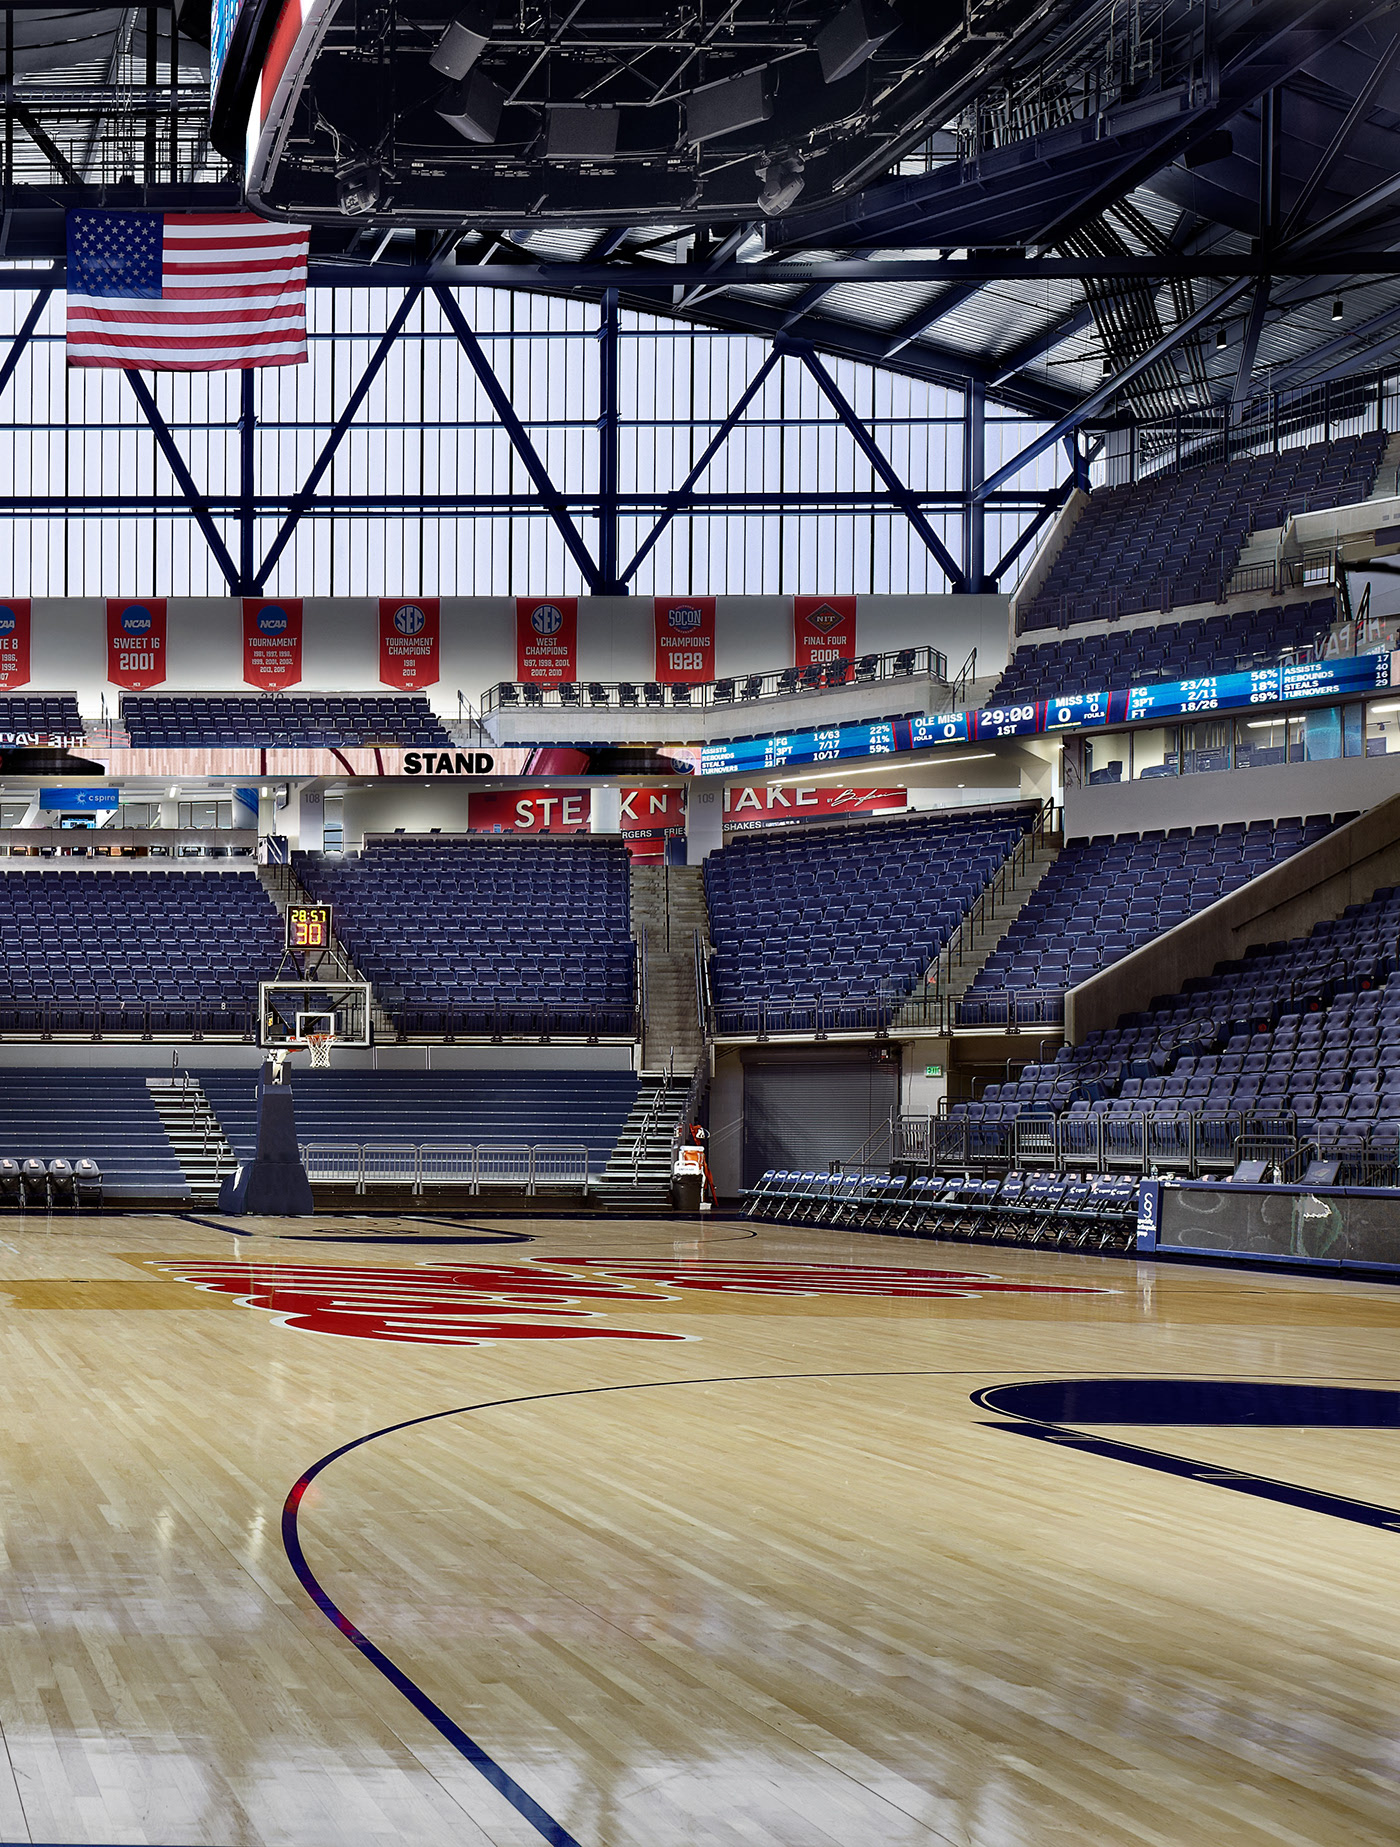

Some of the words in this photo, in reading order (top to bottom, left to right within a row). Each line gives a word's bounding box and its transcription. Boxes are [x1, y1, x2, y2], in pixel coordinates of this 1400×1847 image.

[124, 620, 150, 628] NCAA
[260, 620, 286, 628] NCAA
[397, 608, 422, 632] SEC
[534, 608, 560, 632] SEC
[12, 639, 18, 649] 8
[114, 638, 148, 648] SWEET
[151, 638, 160, 648] 16
[249, 638, 297, 646] TOURNAMENT
[386, 638, 434, 646] TOURNAMENT
[536, 638, 557, 646] WEST
[661, 637, 710, 647] CHAMPIONS
[804, 636, 825, 645] FINAL
[828, 636, 846, 644] FOUR
[388, 647, 430, 655] CHAMPIONS
[526, 647, 568, 655] CHAMPIONS
[811, 650, 839, 662] 2008
[120, 653, 154, 670] 2001
[668, 653, 702, 670] 1928
[1284, 664, 1322, 674] ASSISTS
[1377, 654, 1389, 662] 17
[1284, 671, 1334, 682] REBOUNDS
[1376, 663, 1388, 671] 40
[1132, 687, 1148, 698] FG
[1180, 678, 1217, 691] 23/41
[1251, 670, 1278, 680] 56%
[1284, 680, 1319, 690] STEALS
[1284, 685, 1340, 698] TURNOVERS
[1375, 678, 1388, 687] 29
[1132, 696, 1154, 708] 3PT
[1188, 690, 1217, 700] 2/11
[1251, 680, 1278, 692] 18%
[1056, 696, 1082, 708] MISS
[1086, 693, 1100, 703] ST
[1132, 708, 1146, 718] FT
[1180, 700, 1218, 712] 18/26
[1250, 692, 1278, 702] 69%
[1090, 703, 1098, 712] 0
[915, 718, 934, 727] OLE
[938, 714, 963, 724] MISS
[981, 706, 1034, 726] 29:00
[1058, 708, 1070, 722] 0
[1084, 712, 1104, 720] FOULS
[814, 730, 840, 742] 14/63
[870, 725, 890, 734] 22%
[918, 727, 926, 736] 0
[944, 724, 956, 738] 0
[997, 724, 1017, 736] 1ST
[776, 746, 793, 755] 3PT
[819, 740, 840, 750] 7/17
[870, 735, 890, 744] 41%
[702, 753, 734, 761] REBOUNDS
[776, 758, 786, 766] FT
[814, 750, 840, 760] 10/17
[870, 744, 890, 754] 59%
[404, 753, 494, 774] STAND
[702, 766, 738, 774] TURNOVERS
[304, 794, 320, 804] 108
[698, 794, 714, 804] 109
[723, 821, 762, 831] SHAKES
[622, 830, 652, 838] RGERS
[292, 910, 326, 922] 28:57
[296, 924, 322, 944] 30
